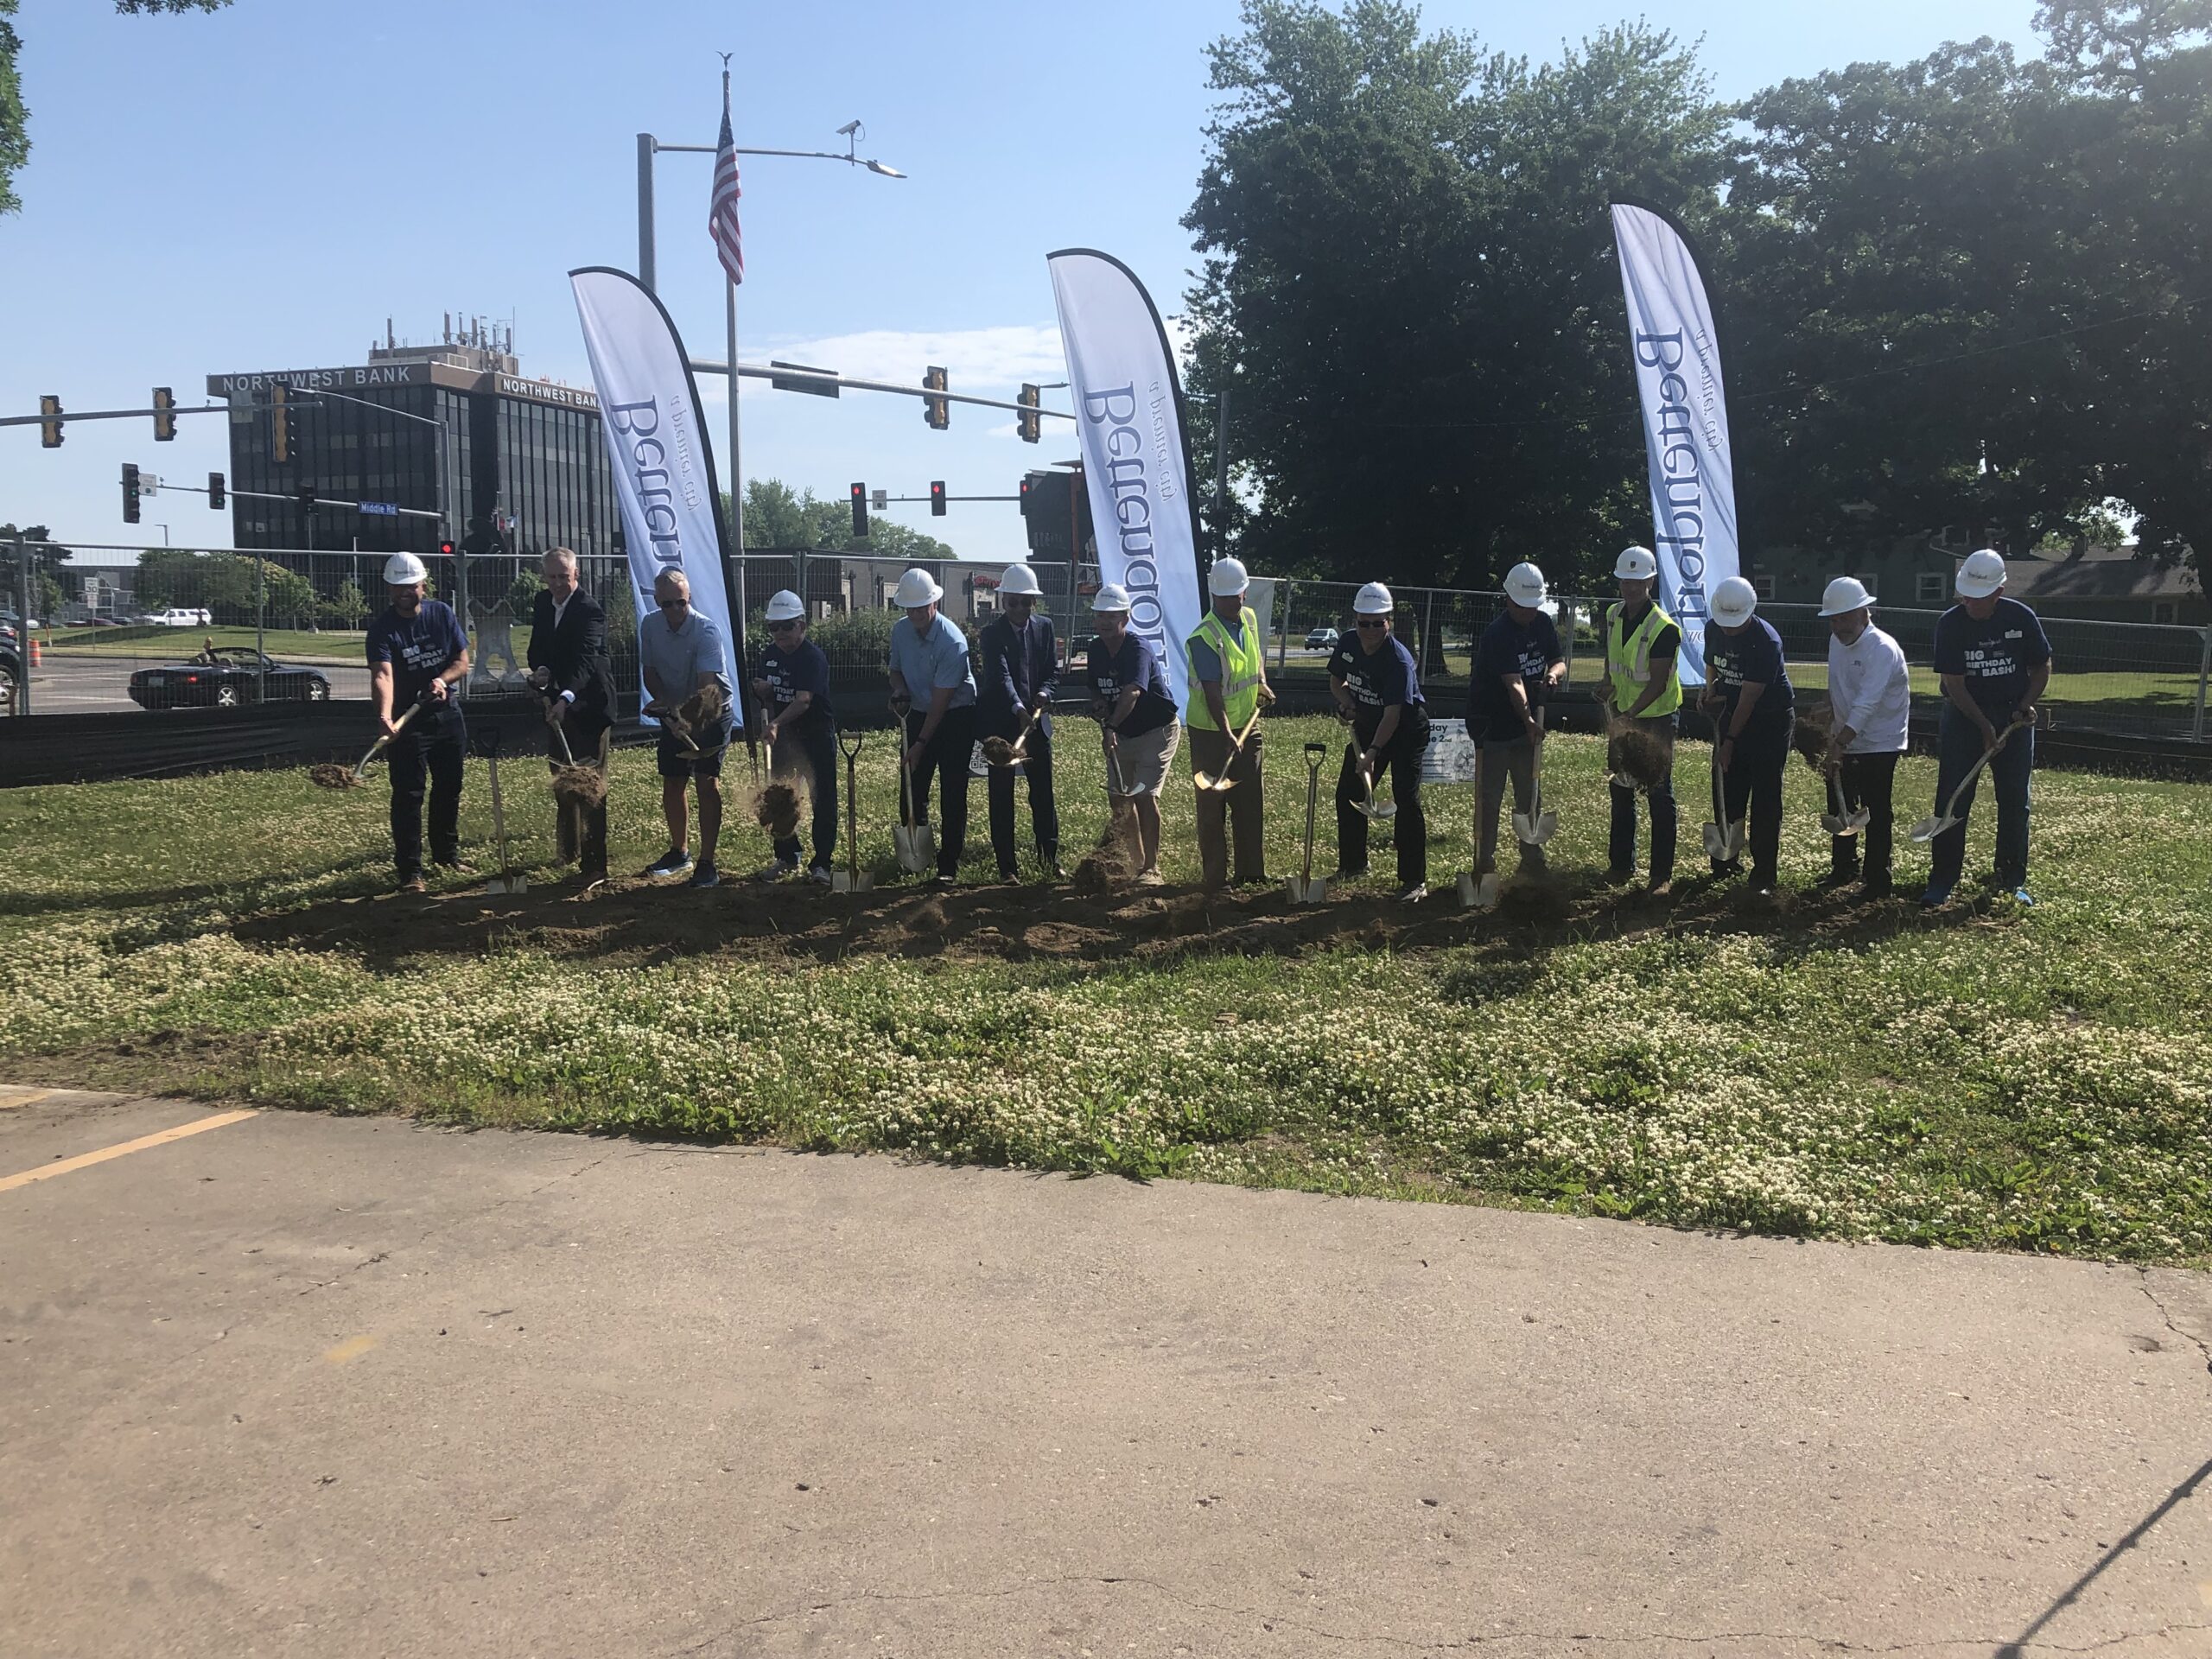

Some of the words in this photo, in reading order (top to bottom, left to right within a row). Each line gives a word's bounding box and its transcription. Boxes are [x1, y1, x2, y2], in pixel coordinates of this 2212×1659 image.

[223, 371, 345, 391] NORTHWEST
[354, 366, 410, 385] BANK
[503, 378, 572, 403] NORTHWEST
[575, 393, 601, 409] BAN
[361, 503, 385, 513] Middle
[386, 505, 396, 513] Rd
[1966, 657, 2012, 669] BIRTHDAY
[1429, 724, 1448, 734] day
